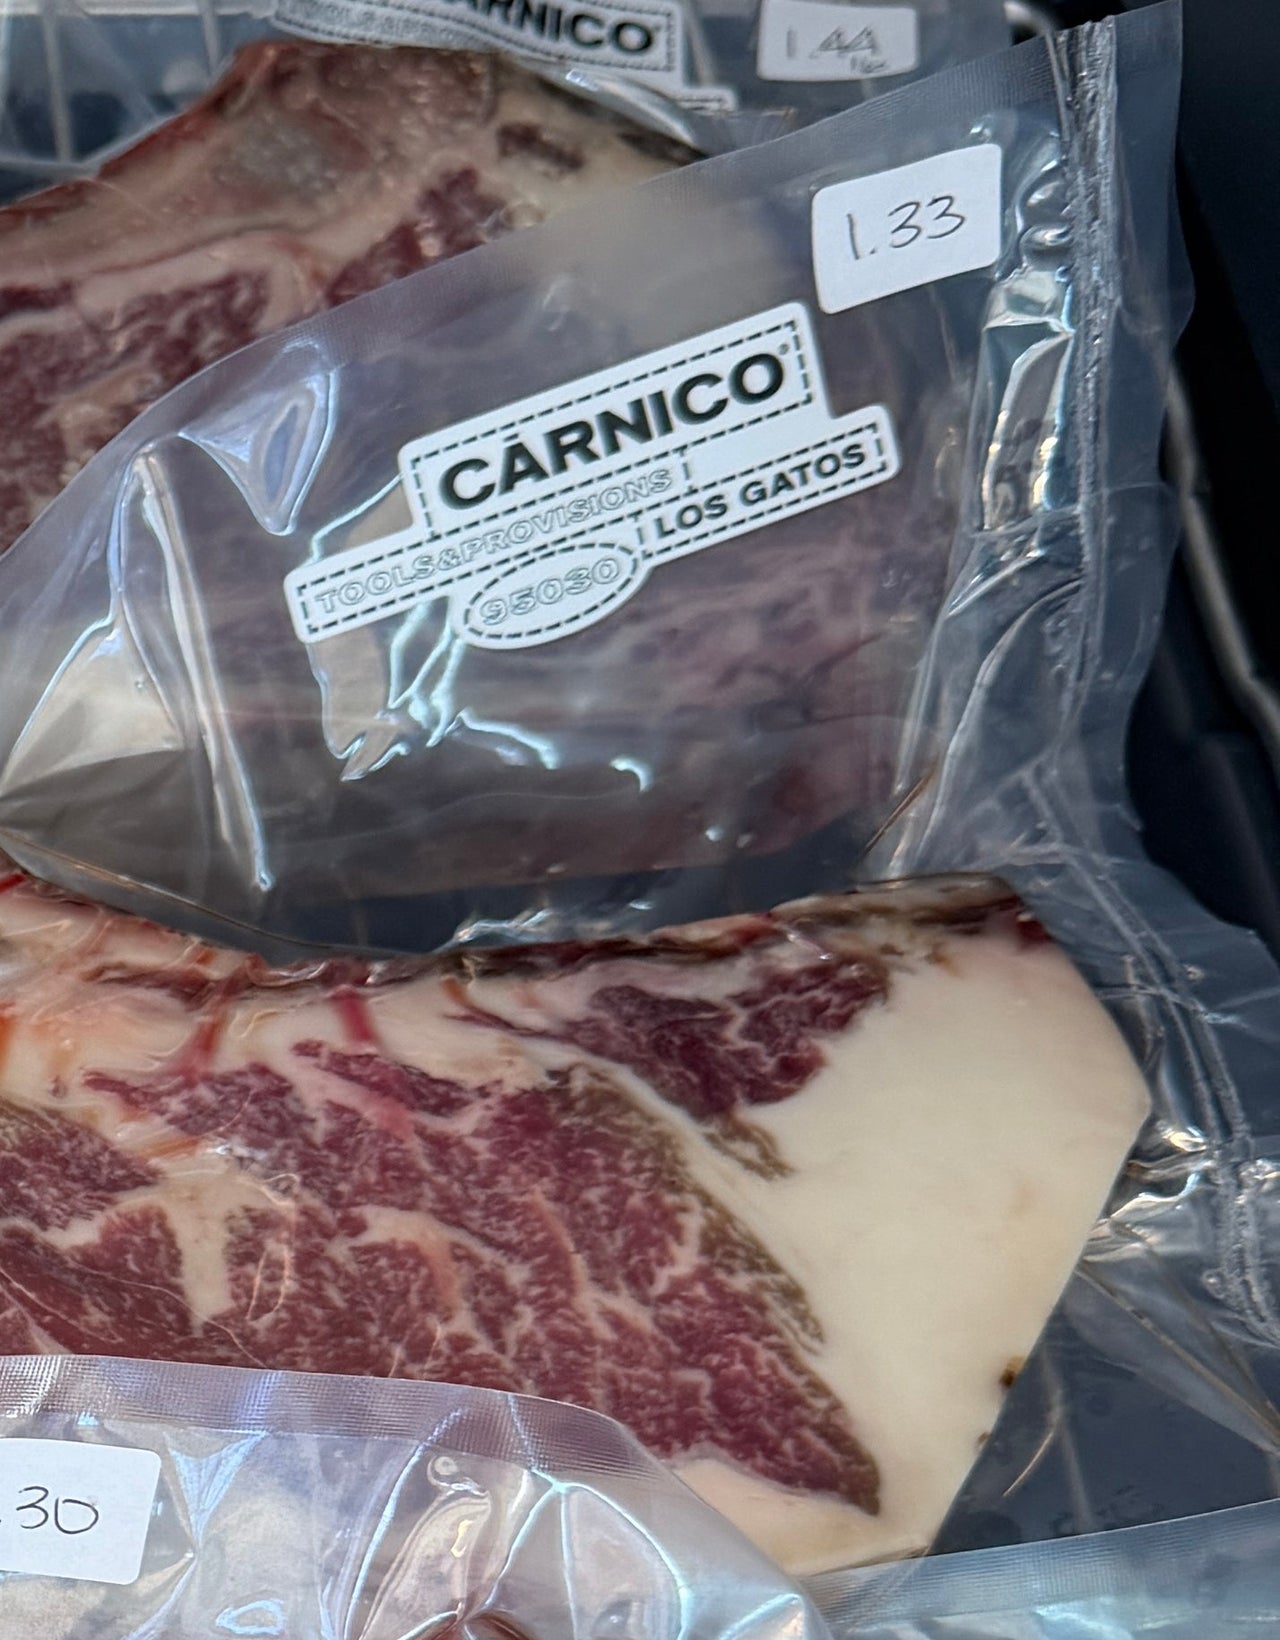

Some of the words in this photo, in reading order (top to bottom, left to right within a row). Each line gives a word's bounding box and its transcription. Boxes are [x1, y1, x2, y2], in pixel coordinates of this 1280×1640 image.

[846, 194, 966, 261] 1.33
[656, 492, 729, 540] LOS
[739, 442, 867, 508] GATOS
[315, 467, 675, 615] TOOLS&PROVISIONS
[478, 556, 622, 627] 95030
